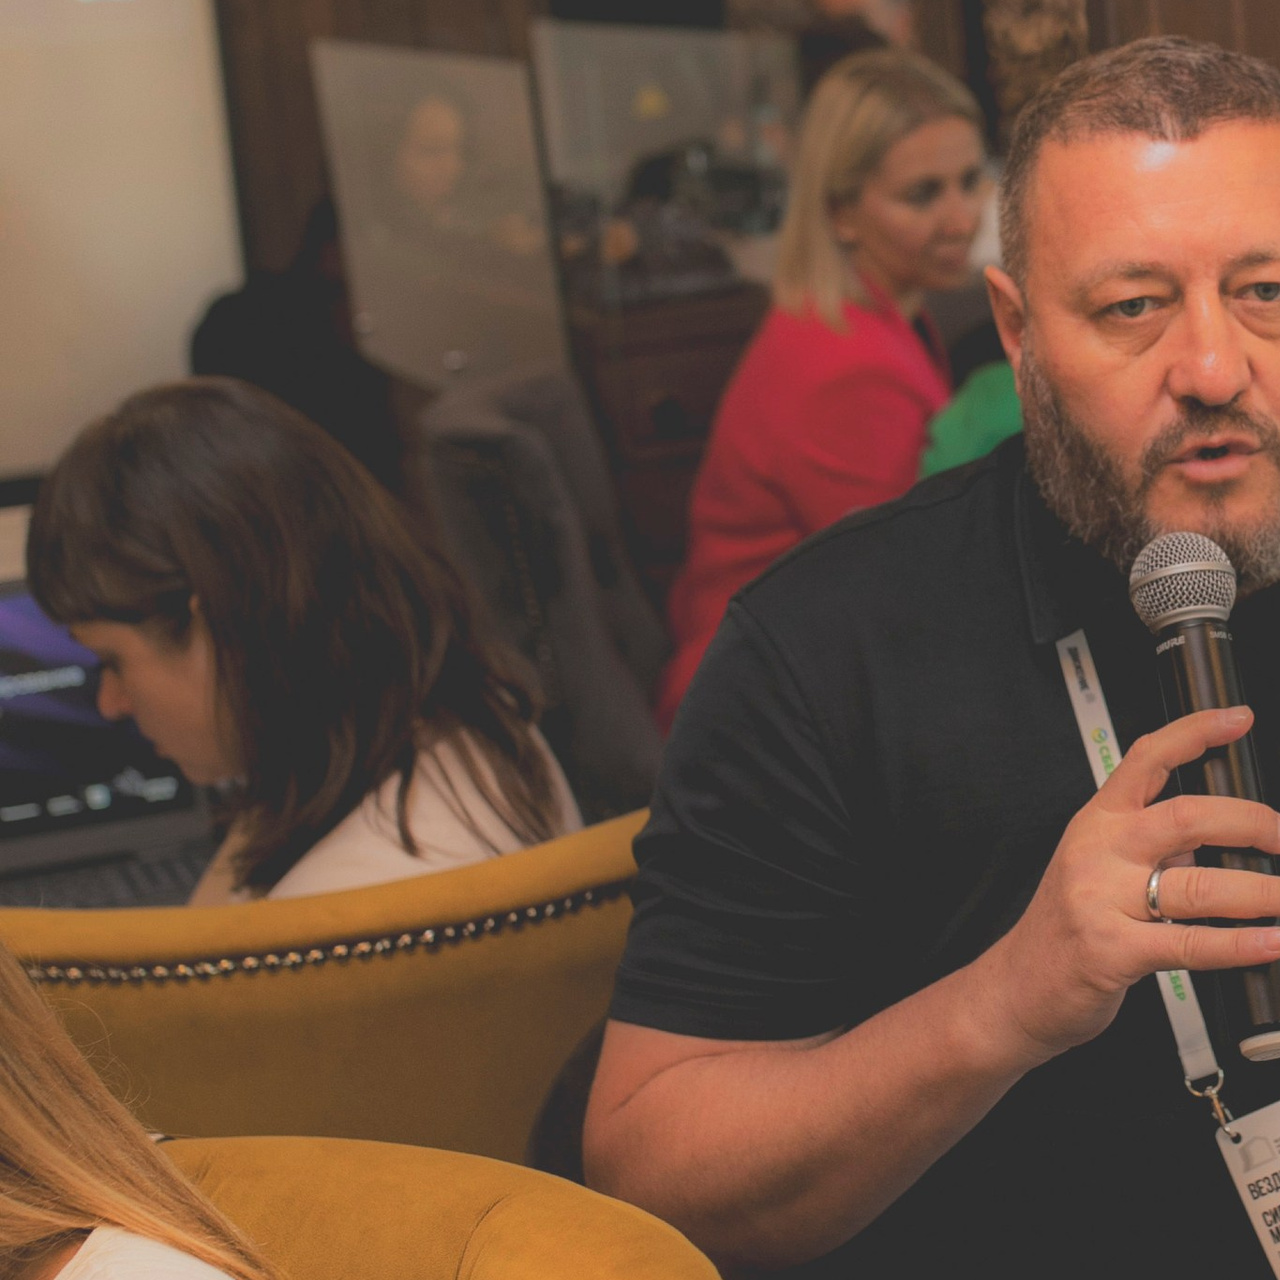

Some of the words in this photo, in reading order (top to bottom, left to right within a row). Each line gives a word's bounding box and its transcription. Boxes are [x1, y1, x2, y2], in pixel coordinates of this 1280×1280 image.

[1156, 635, 1186, 655] SHURE
[1099, 744, 1116, 776] СБЕ
[1169, 972, 1186, 1001] БЕР
